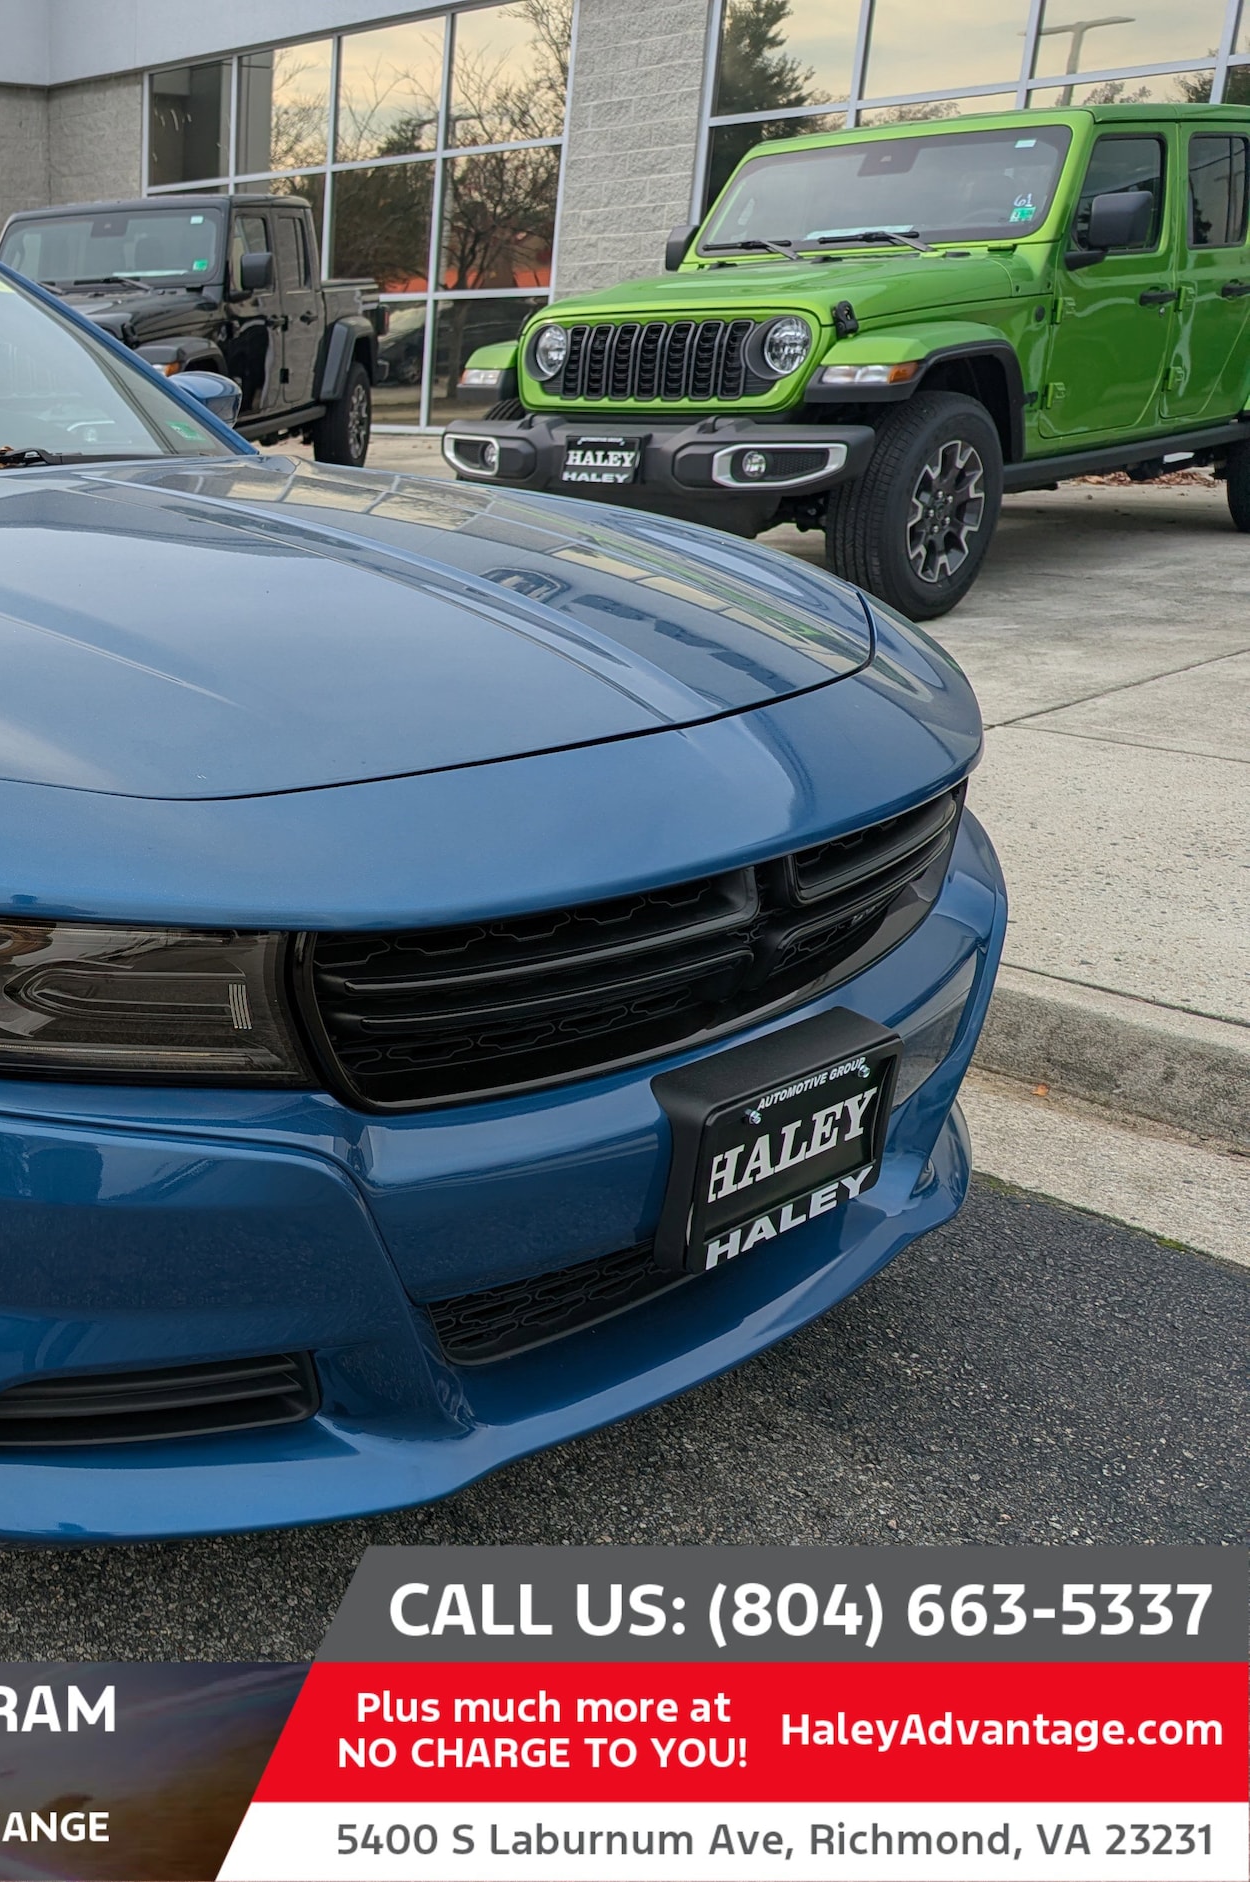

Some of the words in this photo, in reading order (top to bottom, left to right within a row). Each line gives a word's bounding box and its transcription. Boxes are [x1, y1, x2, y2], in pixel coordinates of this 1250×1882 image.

[562, 471, 630, 483] HALEY
[565, 450, 636, 467] HALEY
[757, 1071, 828, 1111] AUTOMOTIVE
[828, 1057, 867, 1082] GROUP
[707, 1087, 878, 1204] HALEY
[705, 1166, 874, 1271] HALEY
